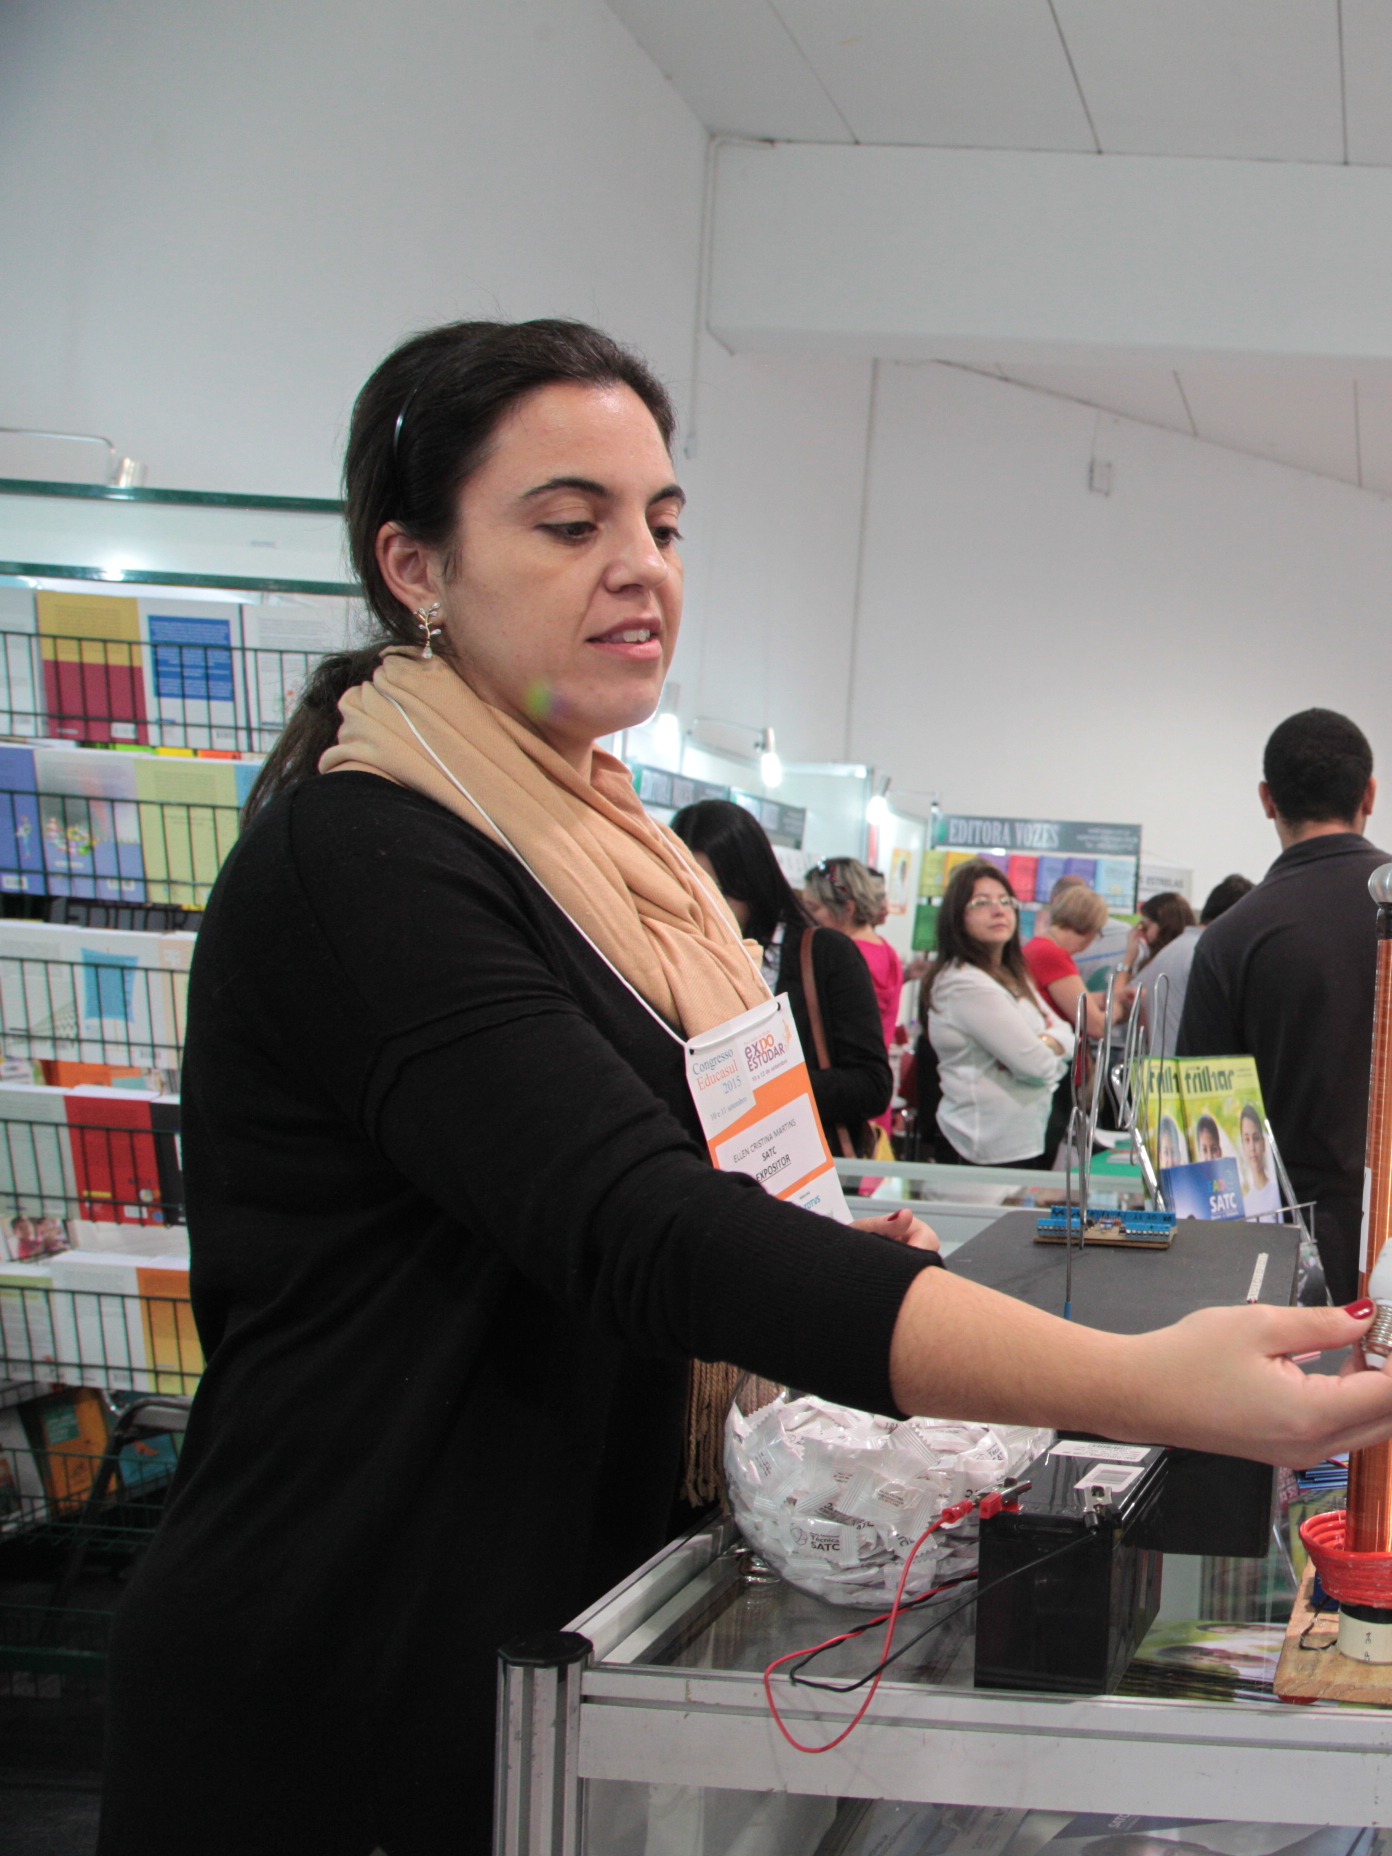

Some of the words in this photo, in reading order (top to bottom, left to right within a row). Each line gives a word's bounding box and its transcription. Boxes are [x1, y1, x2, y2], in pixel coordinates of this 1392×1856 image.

[950, 819, 1011, 846] EDITORA
[1014, 822, 1060, 848] VOZES
[744, 1034, 774, 1060] expo
[747, 1042, 786, 1072] ESTUDAR
[692, 1049, 734, 1075] Congresso
[696, 1058, 738, 1091] Educasul
[723, 1075, 742, 1094] 2015
[733, 1148, 750, 1163] ELLEN
[750, 1134, 773, 1152] CRISTINA
[773, 1119, 796, 1137] MARTINS
[762, 1146, 778, 1161] SATC
[756, 1154, 791, 1182] EXPOSITOR
[1207, 1178, 1226, 1193] EAD
[1210, 1192, 1237, 1213] SATC
[811, 1541, 840, 1551] SATC
